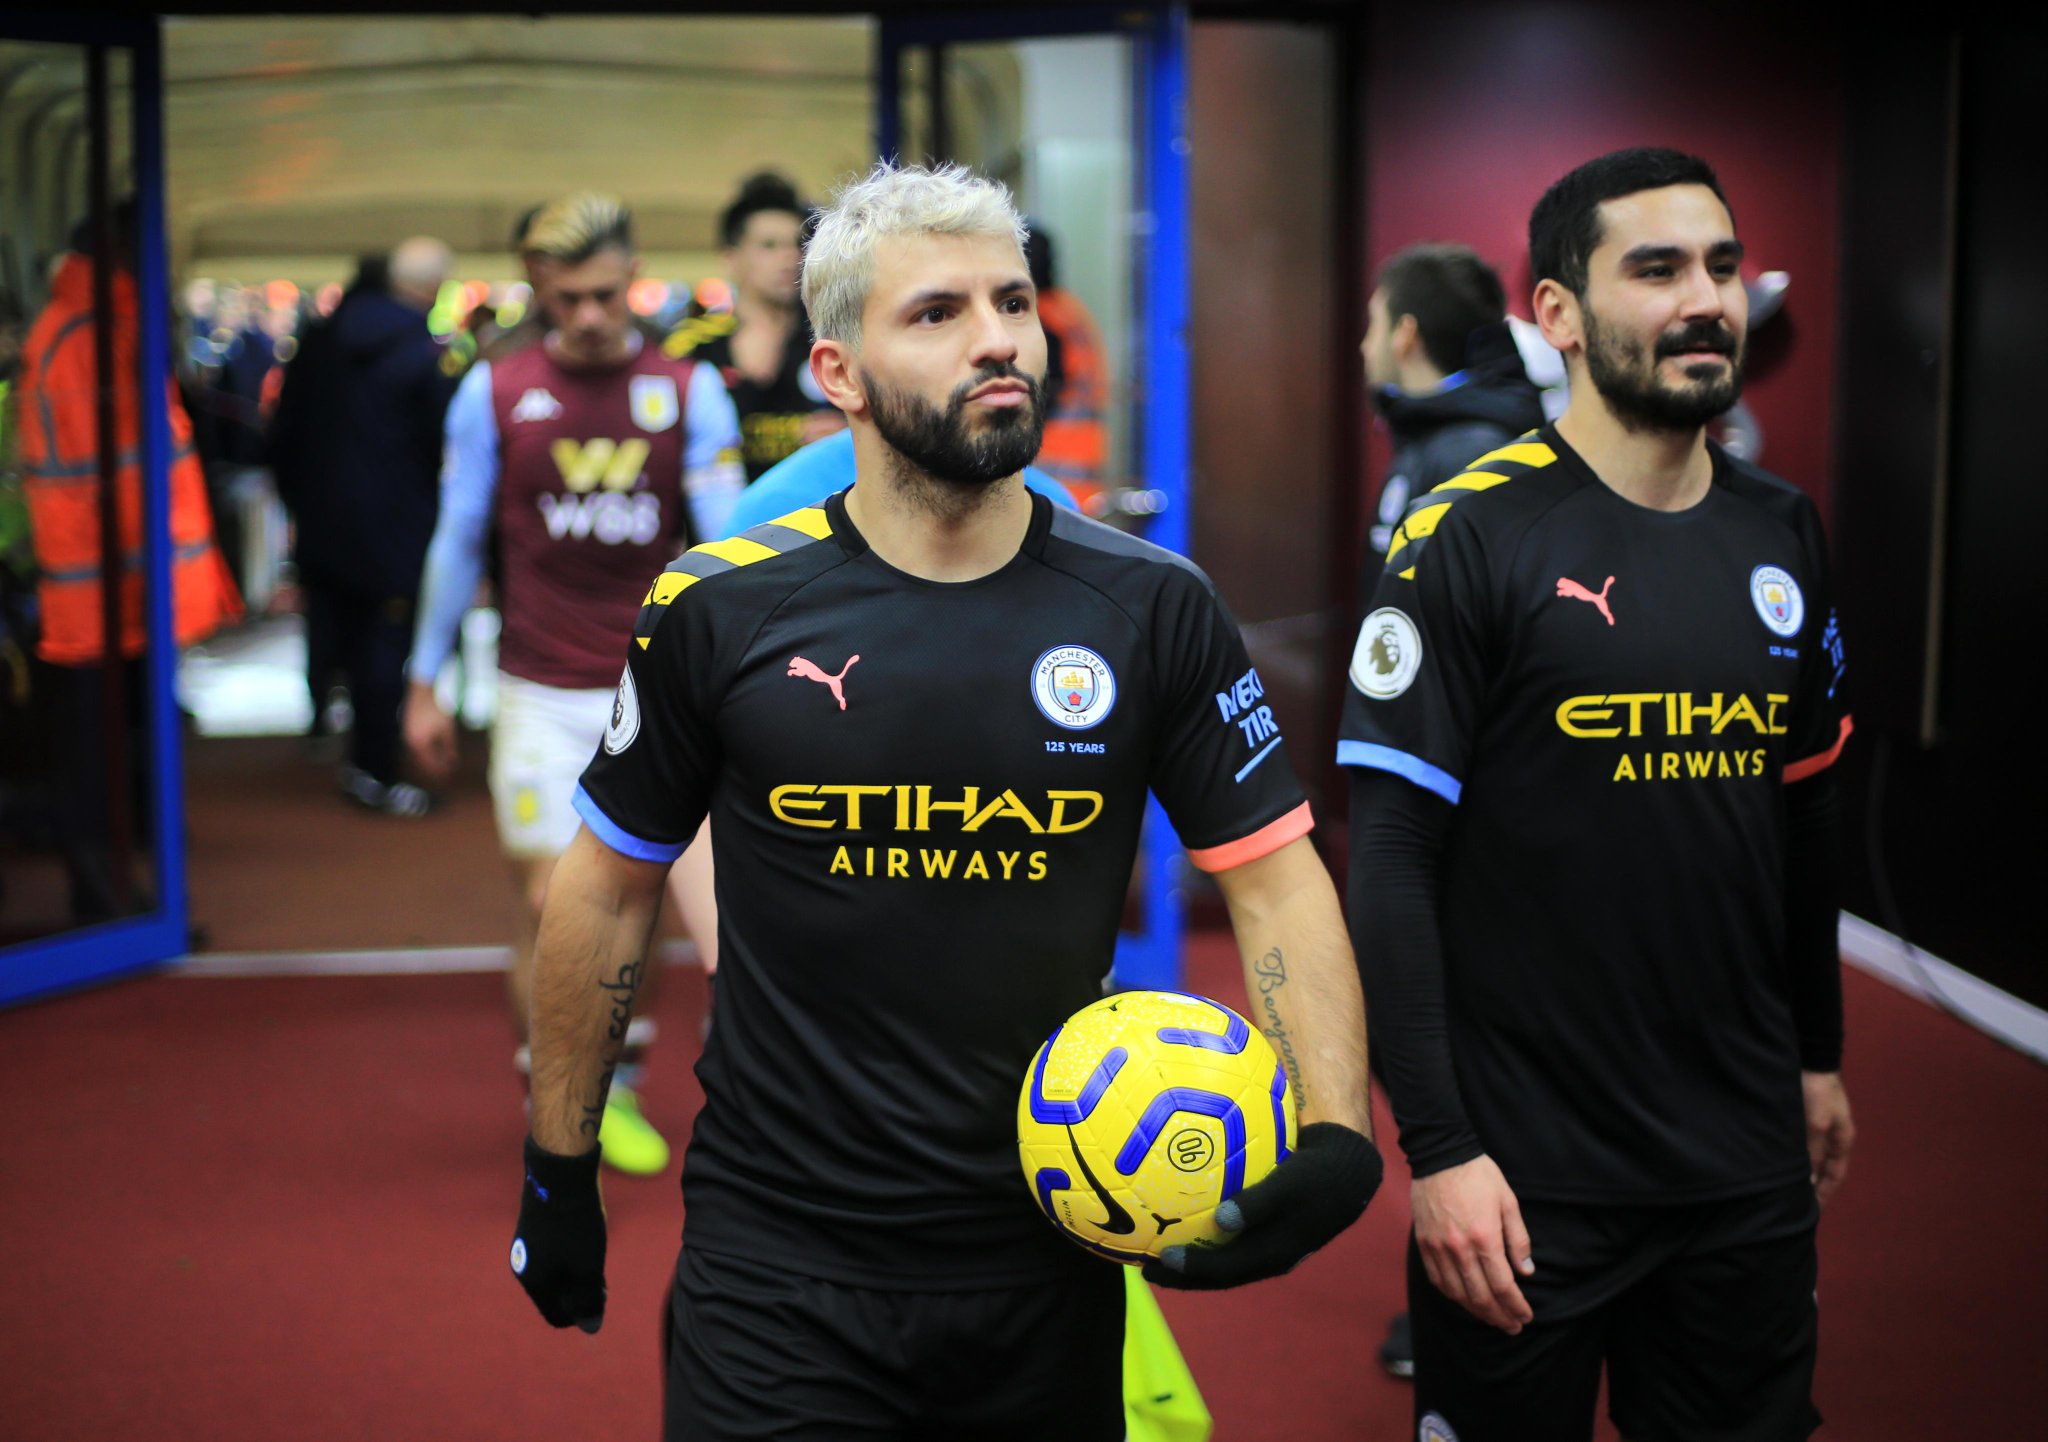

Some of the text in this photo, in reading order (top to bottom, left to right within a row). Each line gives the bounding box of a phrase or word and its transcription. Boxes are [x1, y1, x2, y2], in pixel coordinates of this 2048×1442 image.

[1041, 650, 1106, 676] MANCHESTER
[1064, 714, 1088, 723] CITY
[1045, 741, 1105, 753] 125 YEARS
[1613, 749, 1766, 781] AIRWAYS
[769, 784, 1103, 833] ETIHAD
[829, 846, 1047, 880] AIRWAYS
[1255, 946, 1307, 1111] Benjamin
